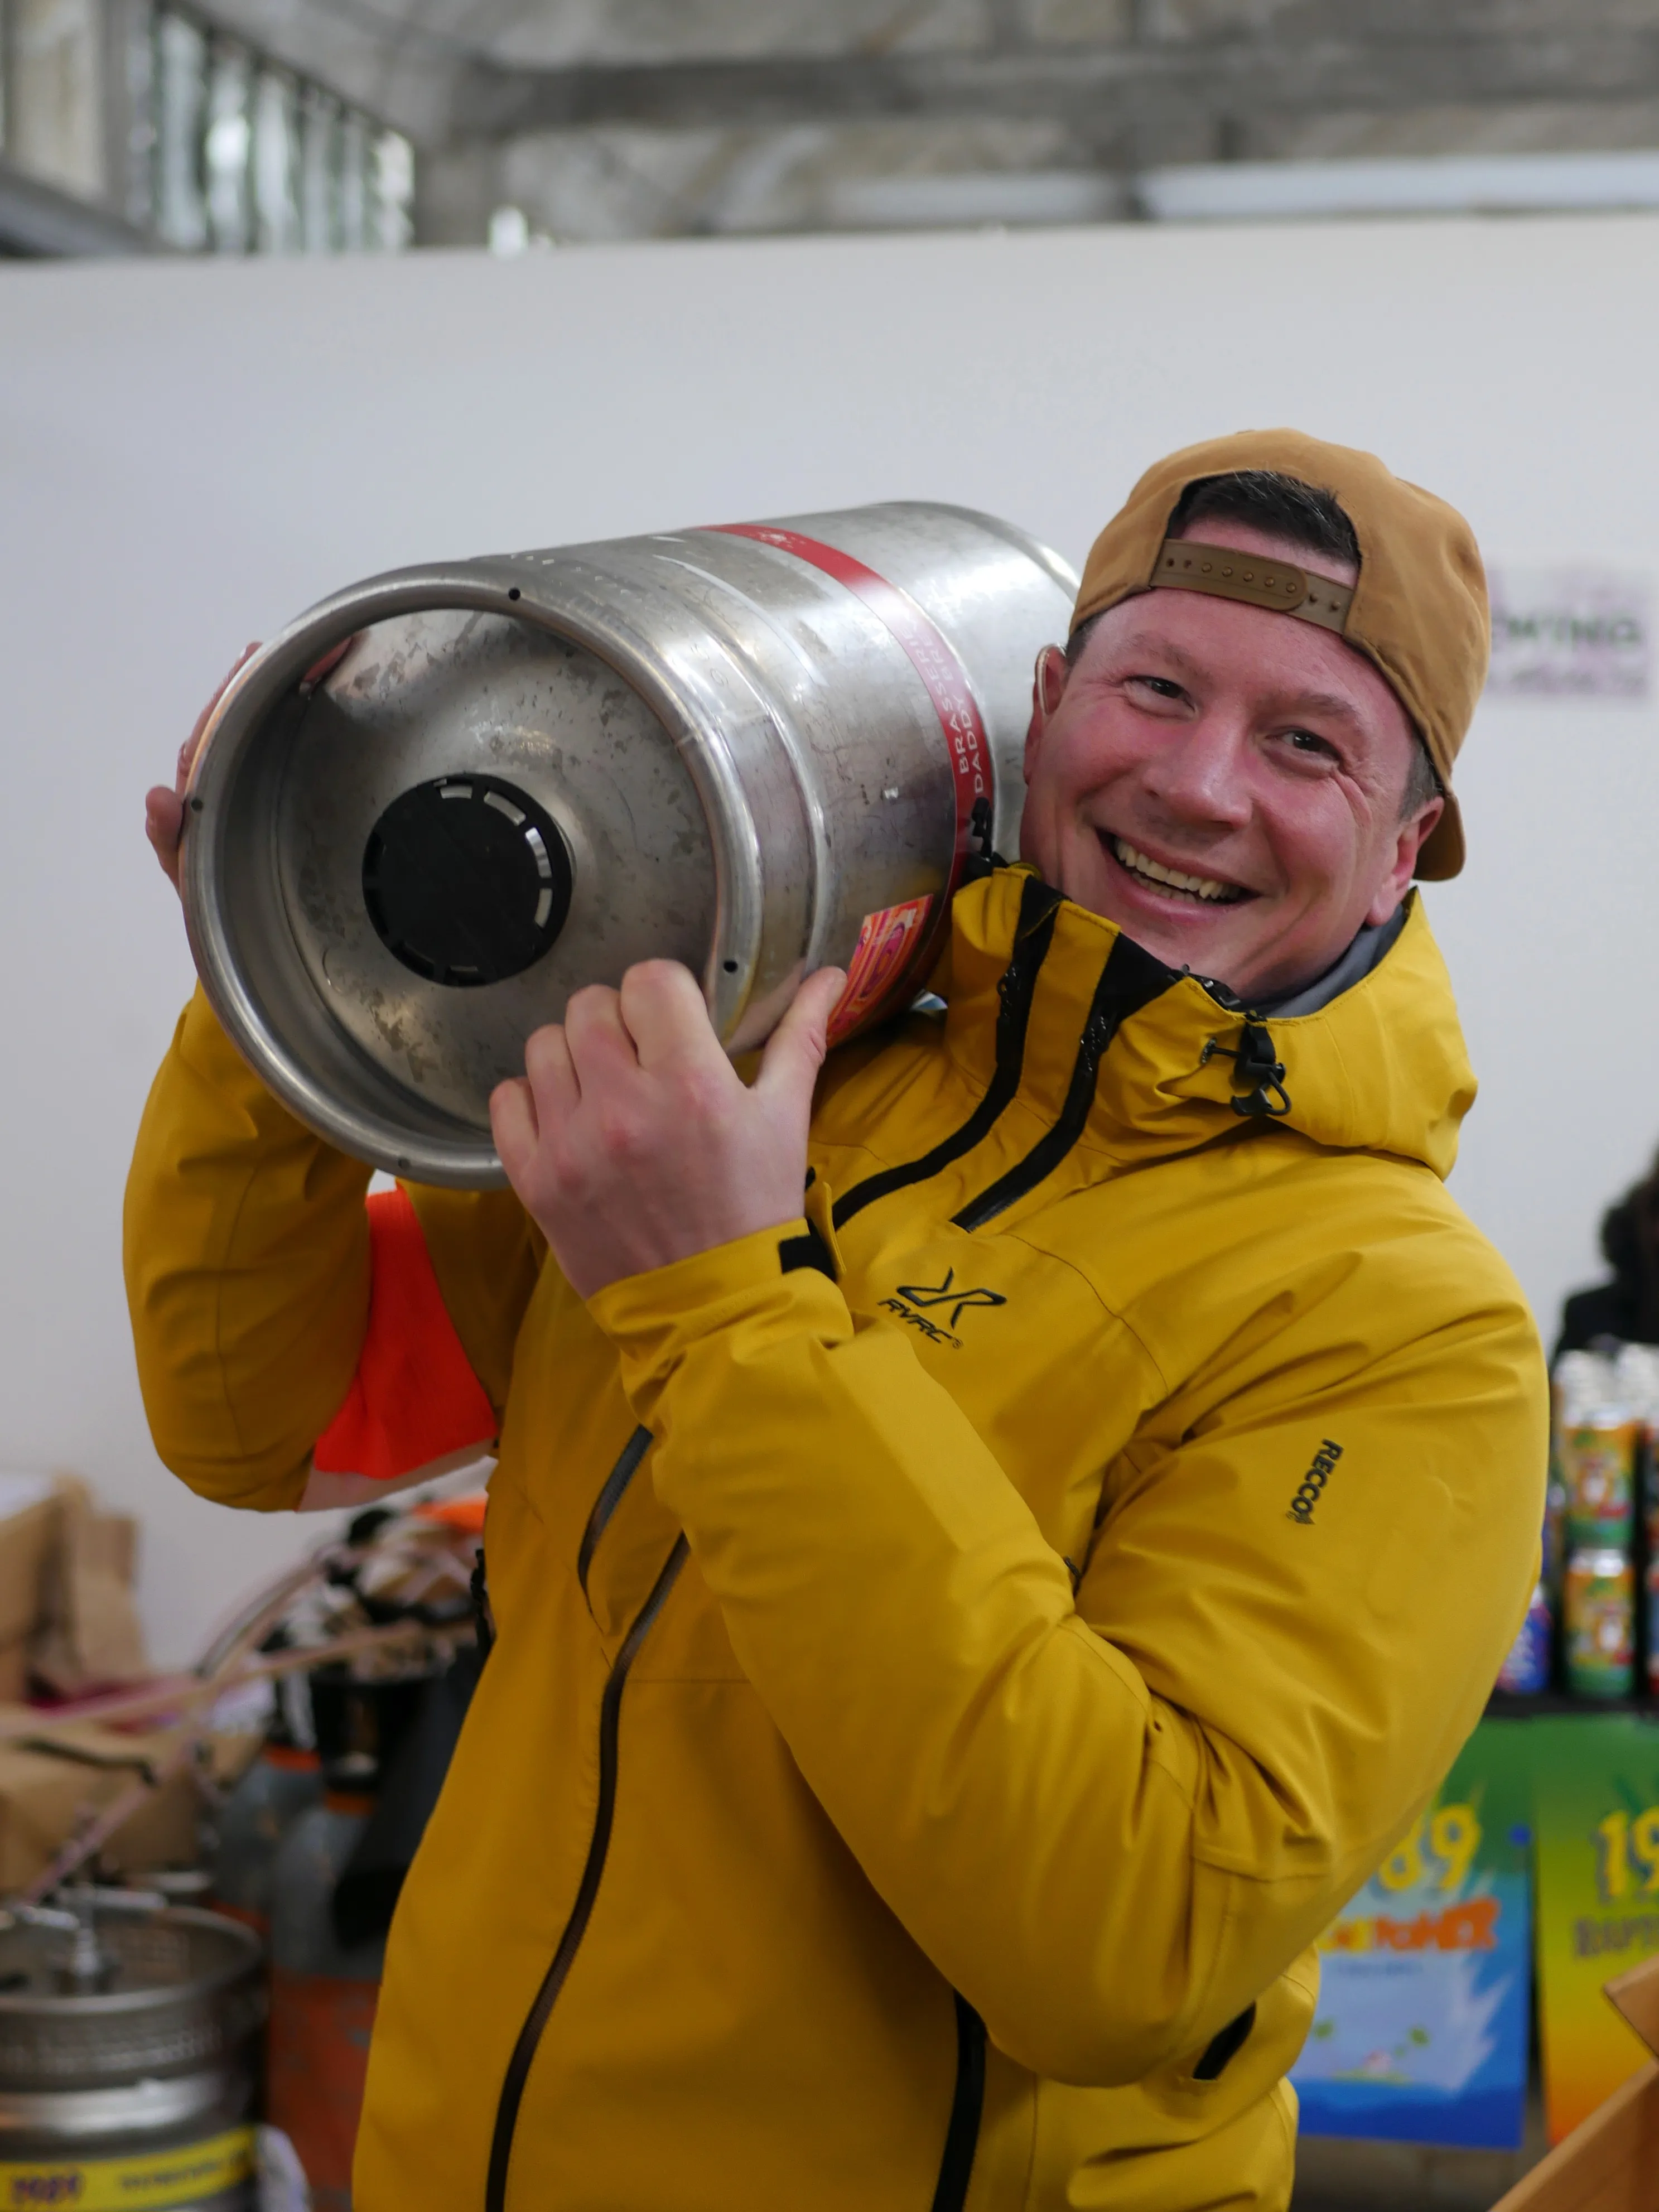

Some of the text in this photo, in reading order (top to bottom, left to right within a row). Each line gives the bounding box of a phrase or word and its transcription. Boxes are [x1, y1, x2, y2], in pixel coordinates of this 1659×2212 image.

[900, 626, 969, 774] BRASSERIE
[951, 695, 984, 793] DADDY
[1291, 1438, 1344, 1515] RECCO
